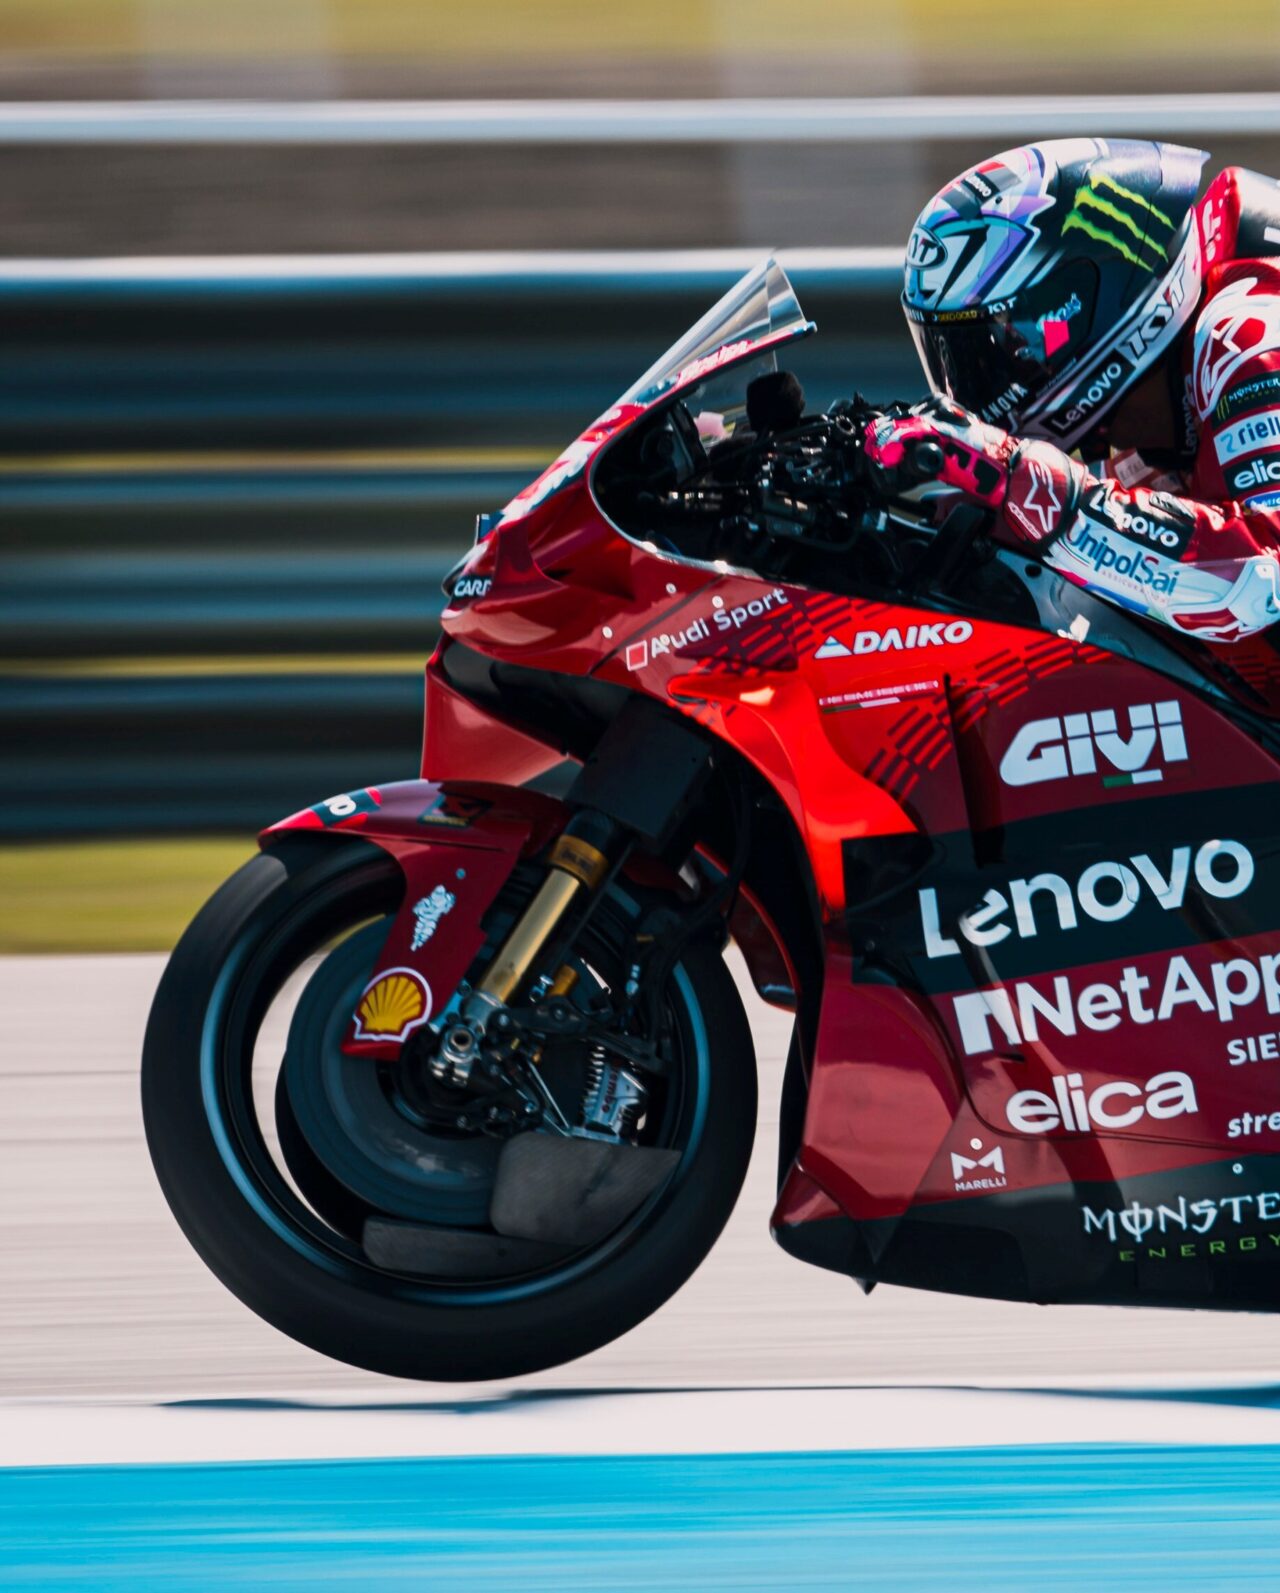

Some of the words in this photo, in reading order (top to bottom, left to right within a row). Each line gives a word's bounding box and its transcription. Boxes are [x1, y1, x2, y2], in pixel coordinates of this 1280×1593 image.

[987, 296, 1017, 316] KYT
[1119, 252, 1186, 361] KYT
[1051, 362, 1122, 431] Lenovo
[1069, 522, 1180, 596] UnipolSai
[650, 619, 710, 658] Audi
[713, 588, 789, 631] Sport
[852, 620, 974, 655] DAIKO
[1000, 700, 1188, 786] GIVI
[919, 839, 1254, 958] Lenovo
[1005, 1070, 1199, 1134] elica
[954, 1175, 1007, 1191] MARELLI
